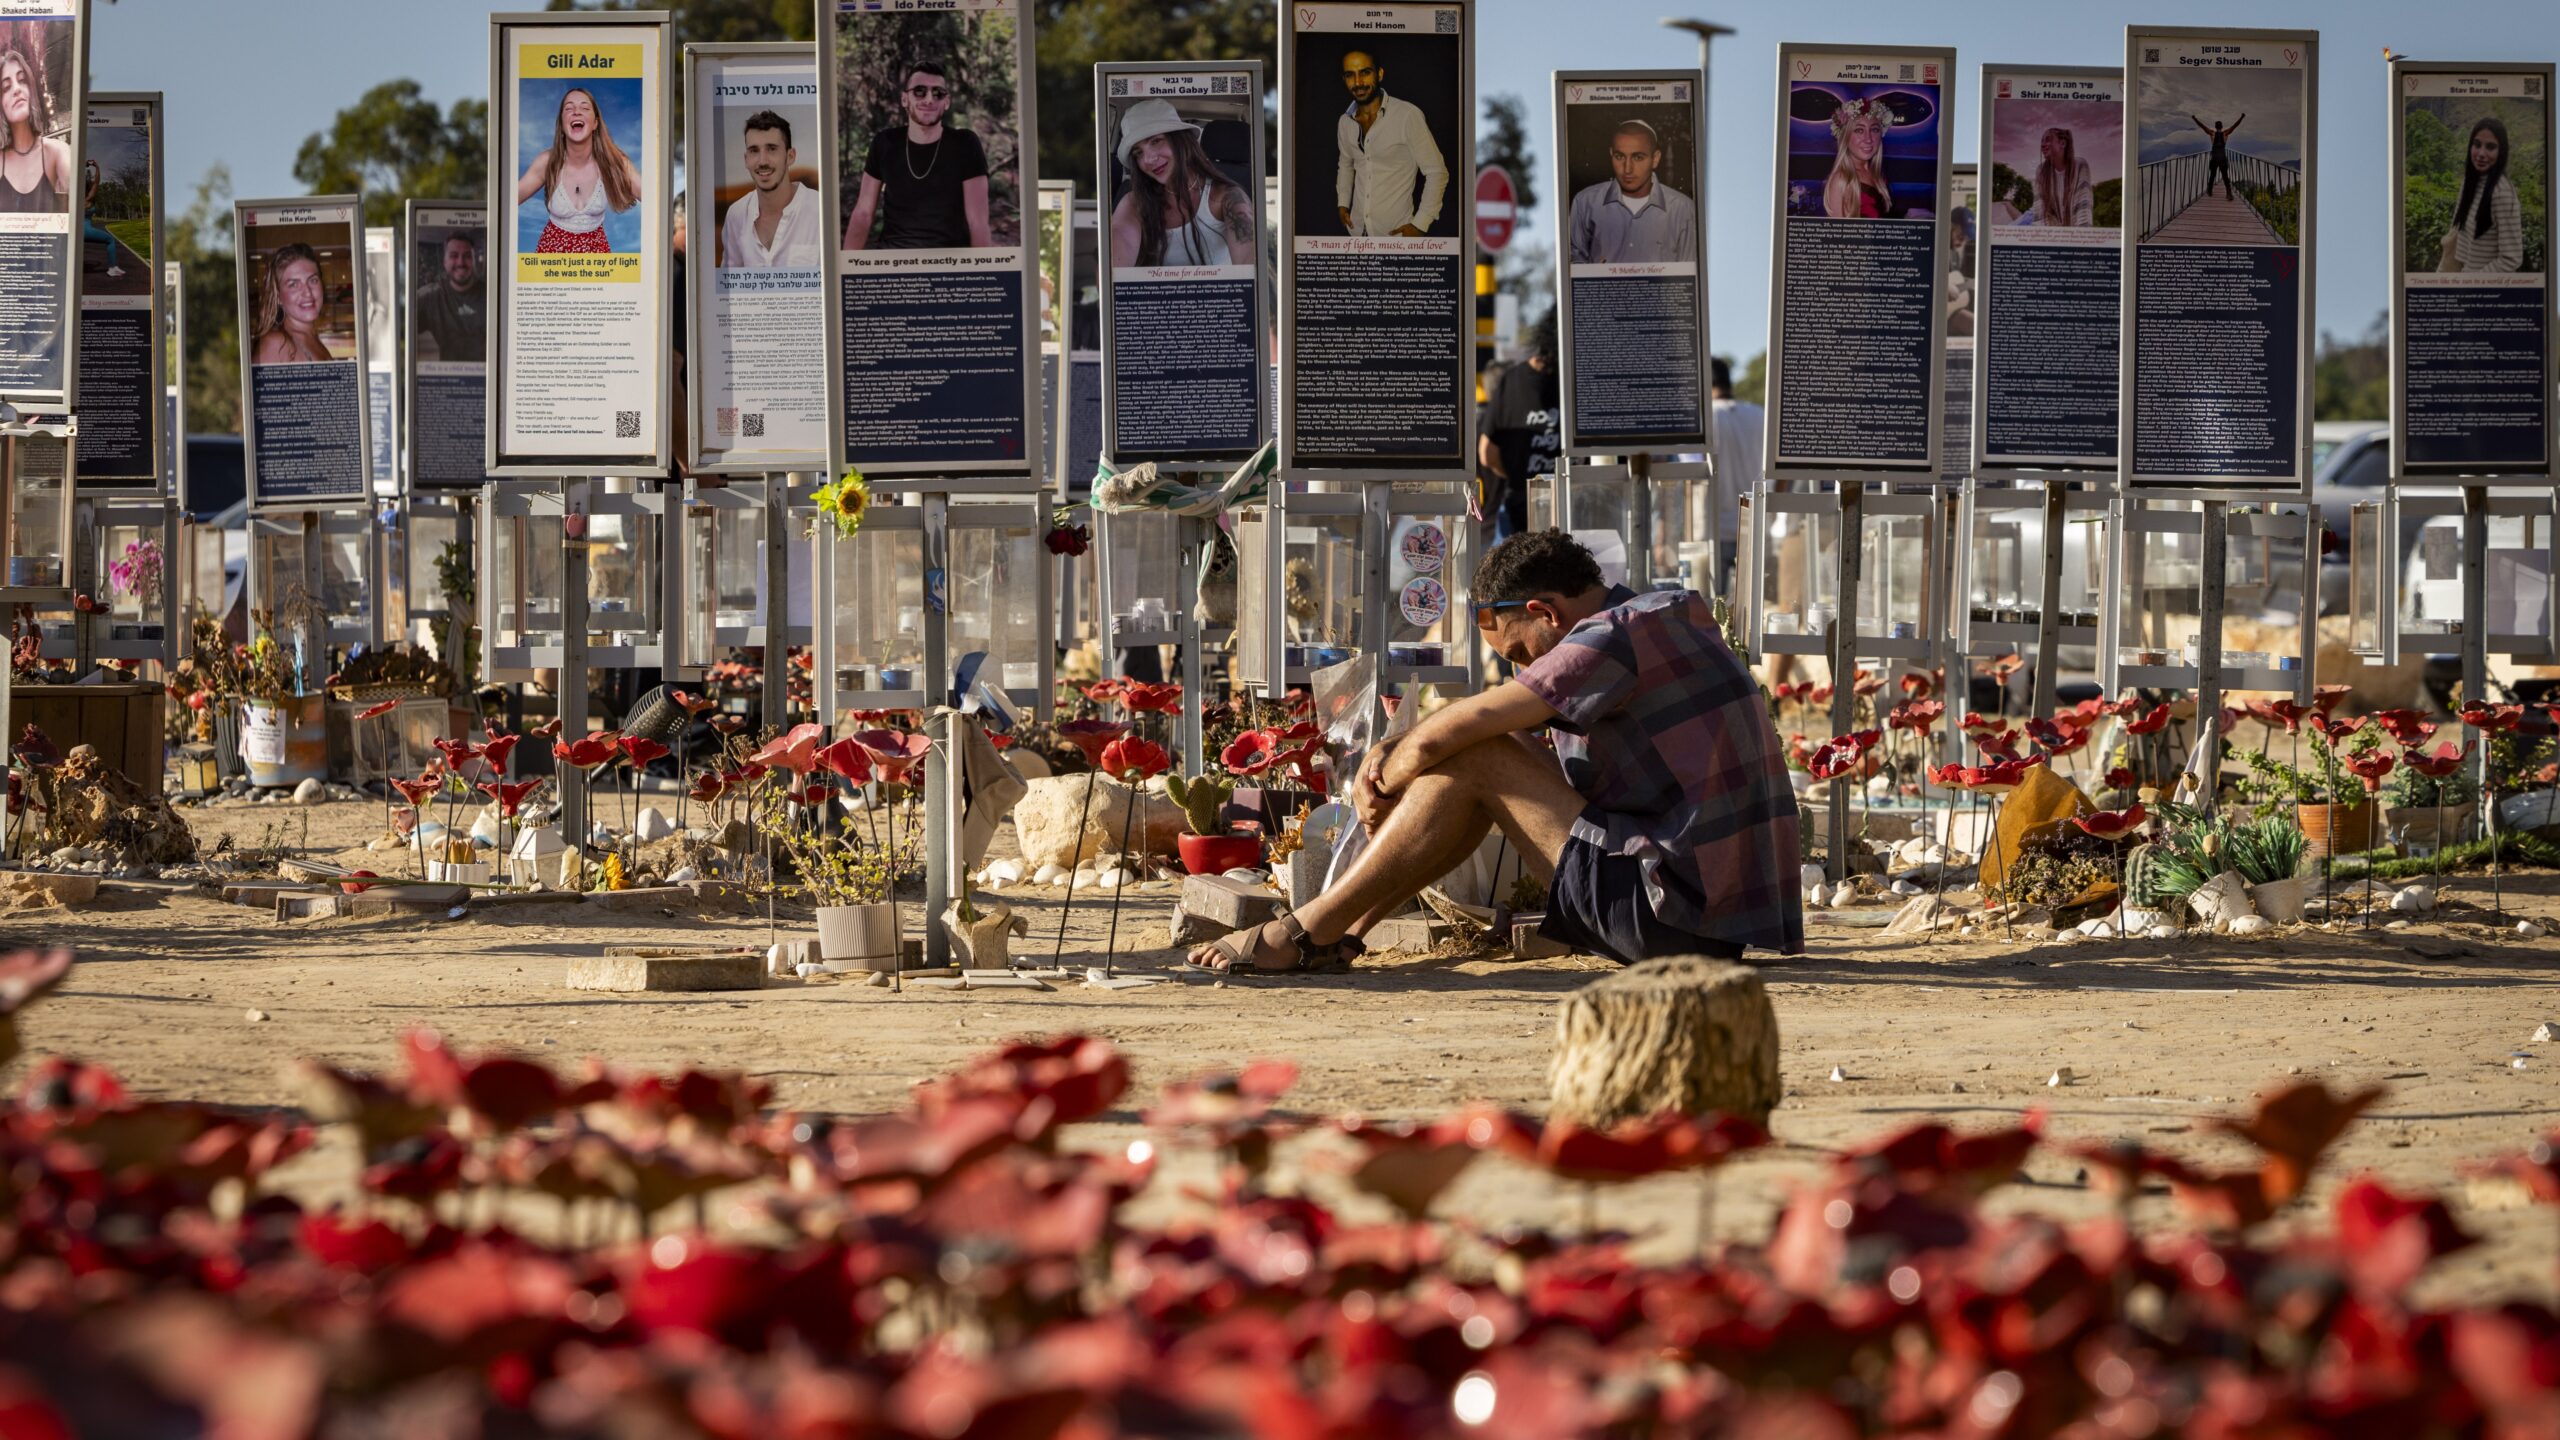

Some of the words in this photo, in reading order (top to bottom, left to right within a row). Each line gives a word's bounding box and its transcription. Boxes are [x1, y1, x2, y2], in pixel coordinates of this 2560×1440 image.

[895, 0, 914, 9] Ido
[917, 0, 956, 9] Peretz
[2, 6, 27, 14] Shaked
[29, 6, 54, 14] Habani
[1354, 22, 1373, 30] Hezi
[1375, 22, 1406, 30] Hanom
[2201, 46, 2222, 54] שושן
[2223, 46, 2241, 54] שגב
[548, 54, 574, 68] Gili
[578, 54, 615, 68] Adar
[2180, 56, 2212, 66] Segev
[2216, 56, 2262, 66] Shushan
[715, 84, 750, 96] טיברג
[752, 82, 784, 96] גלעד
[788, 83, 816, 96] ברהם
[1178, 86, 1208, 94] Gabay
[2020, 90, 2041, 98] Shir
[2044, 91, 2069, 99] Hana
[2072, 92, 2112, 102] Georgie
[1307, 240, 1318, 249] "A
[1342, 239, 1353, 252] of
[1354, 240, 1376, 252] light,
[1378, 241, 1406, 250] music,
[1408, 240, 1425, 250] and
[1427, 240, 1448, 250] love"
[521, 257, 538, 266] "Gili
[540, 258, 567, 266] wasn't
[568, 257, 584, 268] just
[594, 259, 606, 268] ray
[608, 257, 617, 266] of
[619, 258, 638, 268] light
[848, 258, 872, 266] "You
[892, 258, 919, 267] great
[922, 257, 957, 266] exactly
[974, 258, 992, 266] you
[994, 255, 1016, 264] are"
[544, 269, 559, 278] she
[580, 269, 592, 278] the
[594, 269, 614, 278] sun"
[744, 271, 752, 280] לך
[754, 273, 771, 281] קשה
[1148, 267, 1162, 278] "No
[1180, 268, 1192, 280] for
[1193, 268, 1221, 277] drama"
[740, 282, 757, 290] קשה
[777, 280, 802, 288] שלחבר
